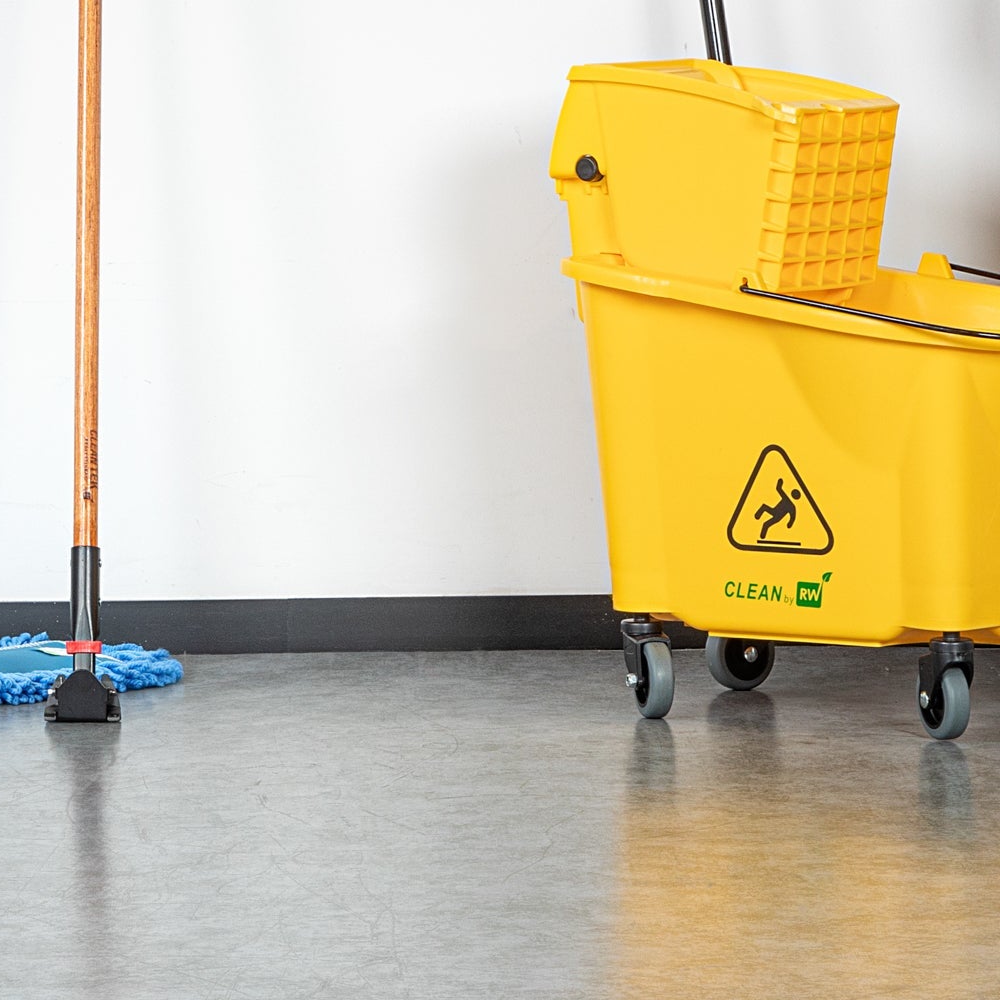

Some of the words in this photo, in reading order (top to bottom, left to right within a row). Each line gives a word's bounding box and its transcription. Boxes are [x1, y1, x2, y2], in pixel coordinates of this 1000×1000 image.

[724, 581, 782, 601] CLEAN
[783, 594, 794, 606] by
[799, 586, 821, 602] RW
